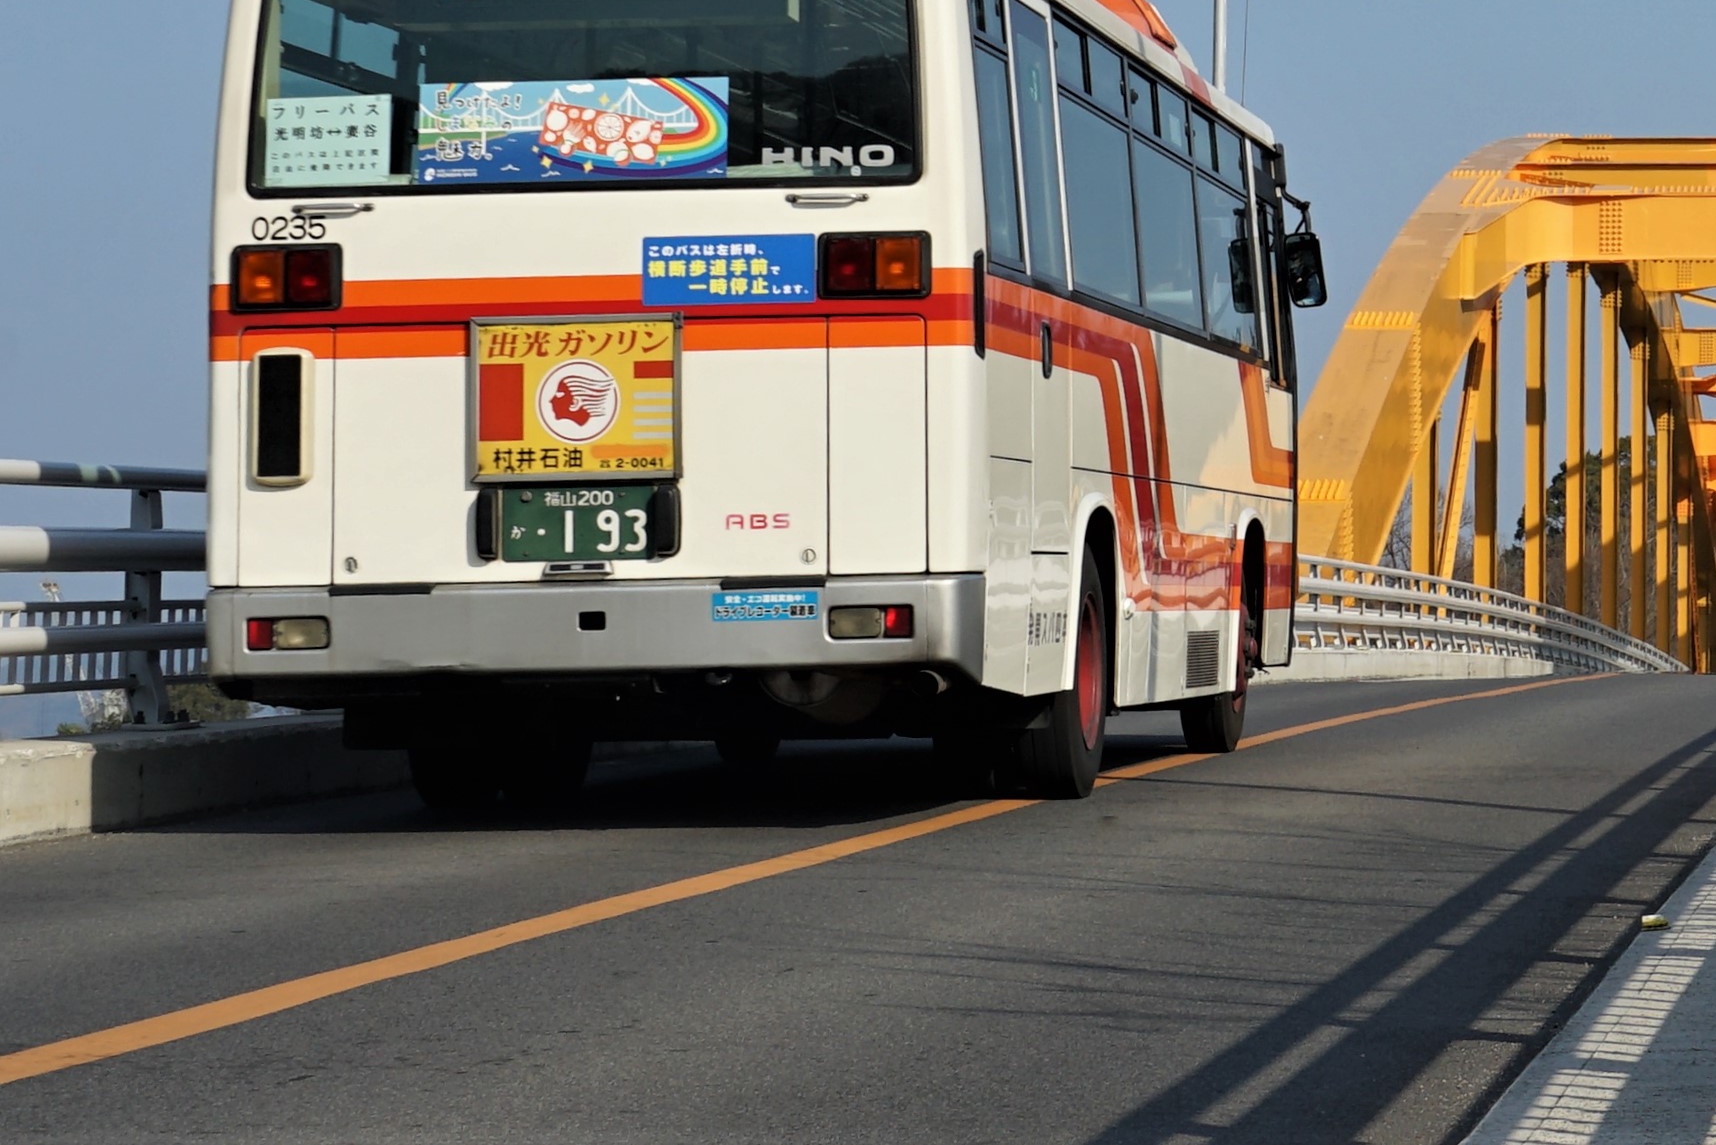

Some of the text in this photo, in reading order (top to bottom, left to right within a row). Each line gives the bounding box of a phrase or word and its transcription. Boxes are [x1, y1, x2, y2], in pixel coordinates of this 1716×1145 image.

[272, 103, 379, 120] フリーバス
[761, 144, 895, 167] HINO
[251, 216, 326, 241] 0235
[648, 244, 764, 257] このバスは左折時、
[648, 258, 781, 278] 横断歩道手前で
[688, 277, 809, 296] 一時停止します。
[487, 329, 669, 358] 出光ガソリン
[493, 447, 665, 469] 村井石油 2-0041
[725, 513, 790, 530] ABS
